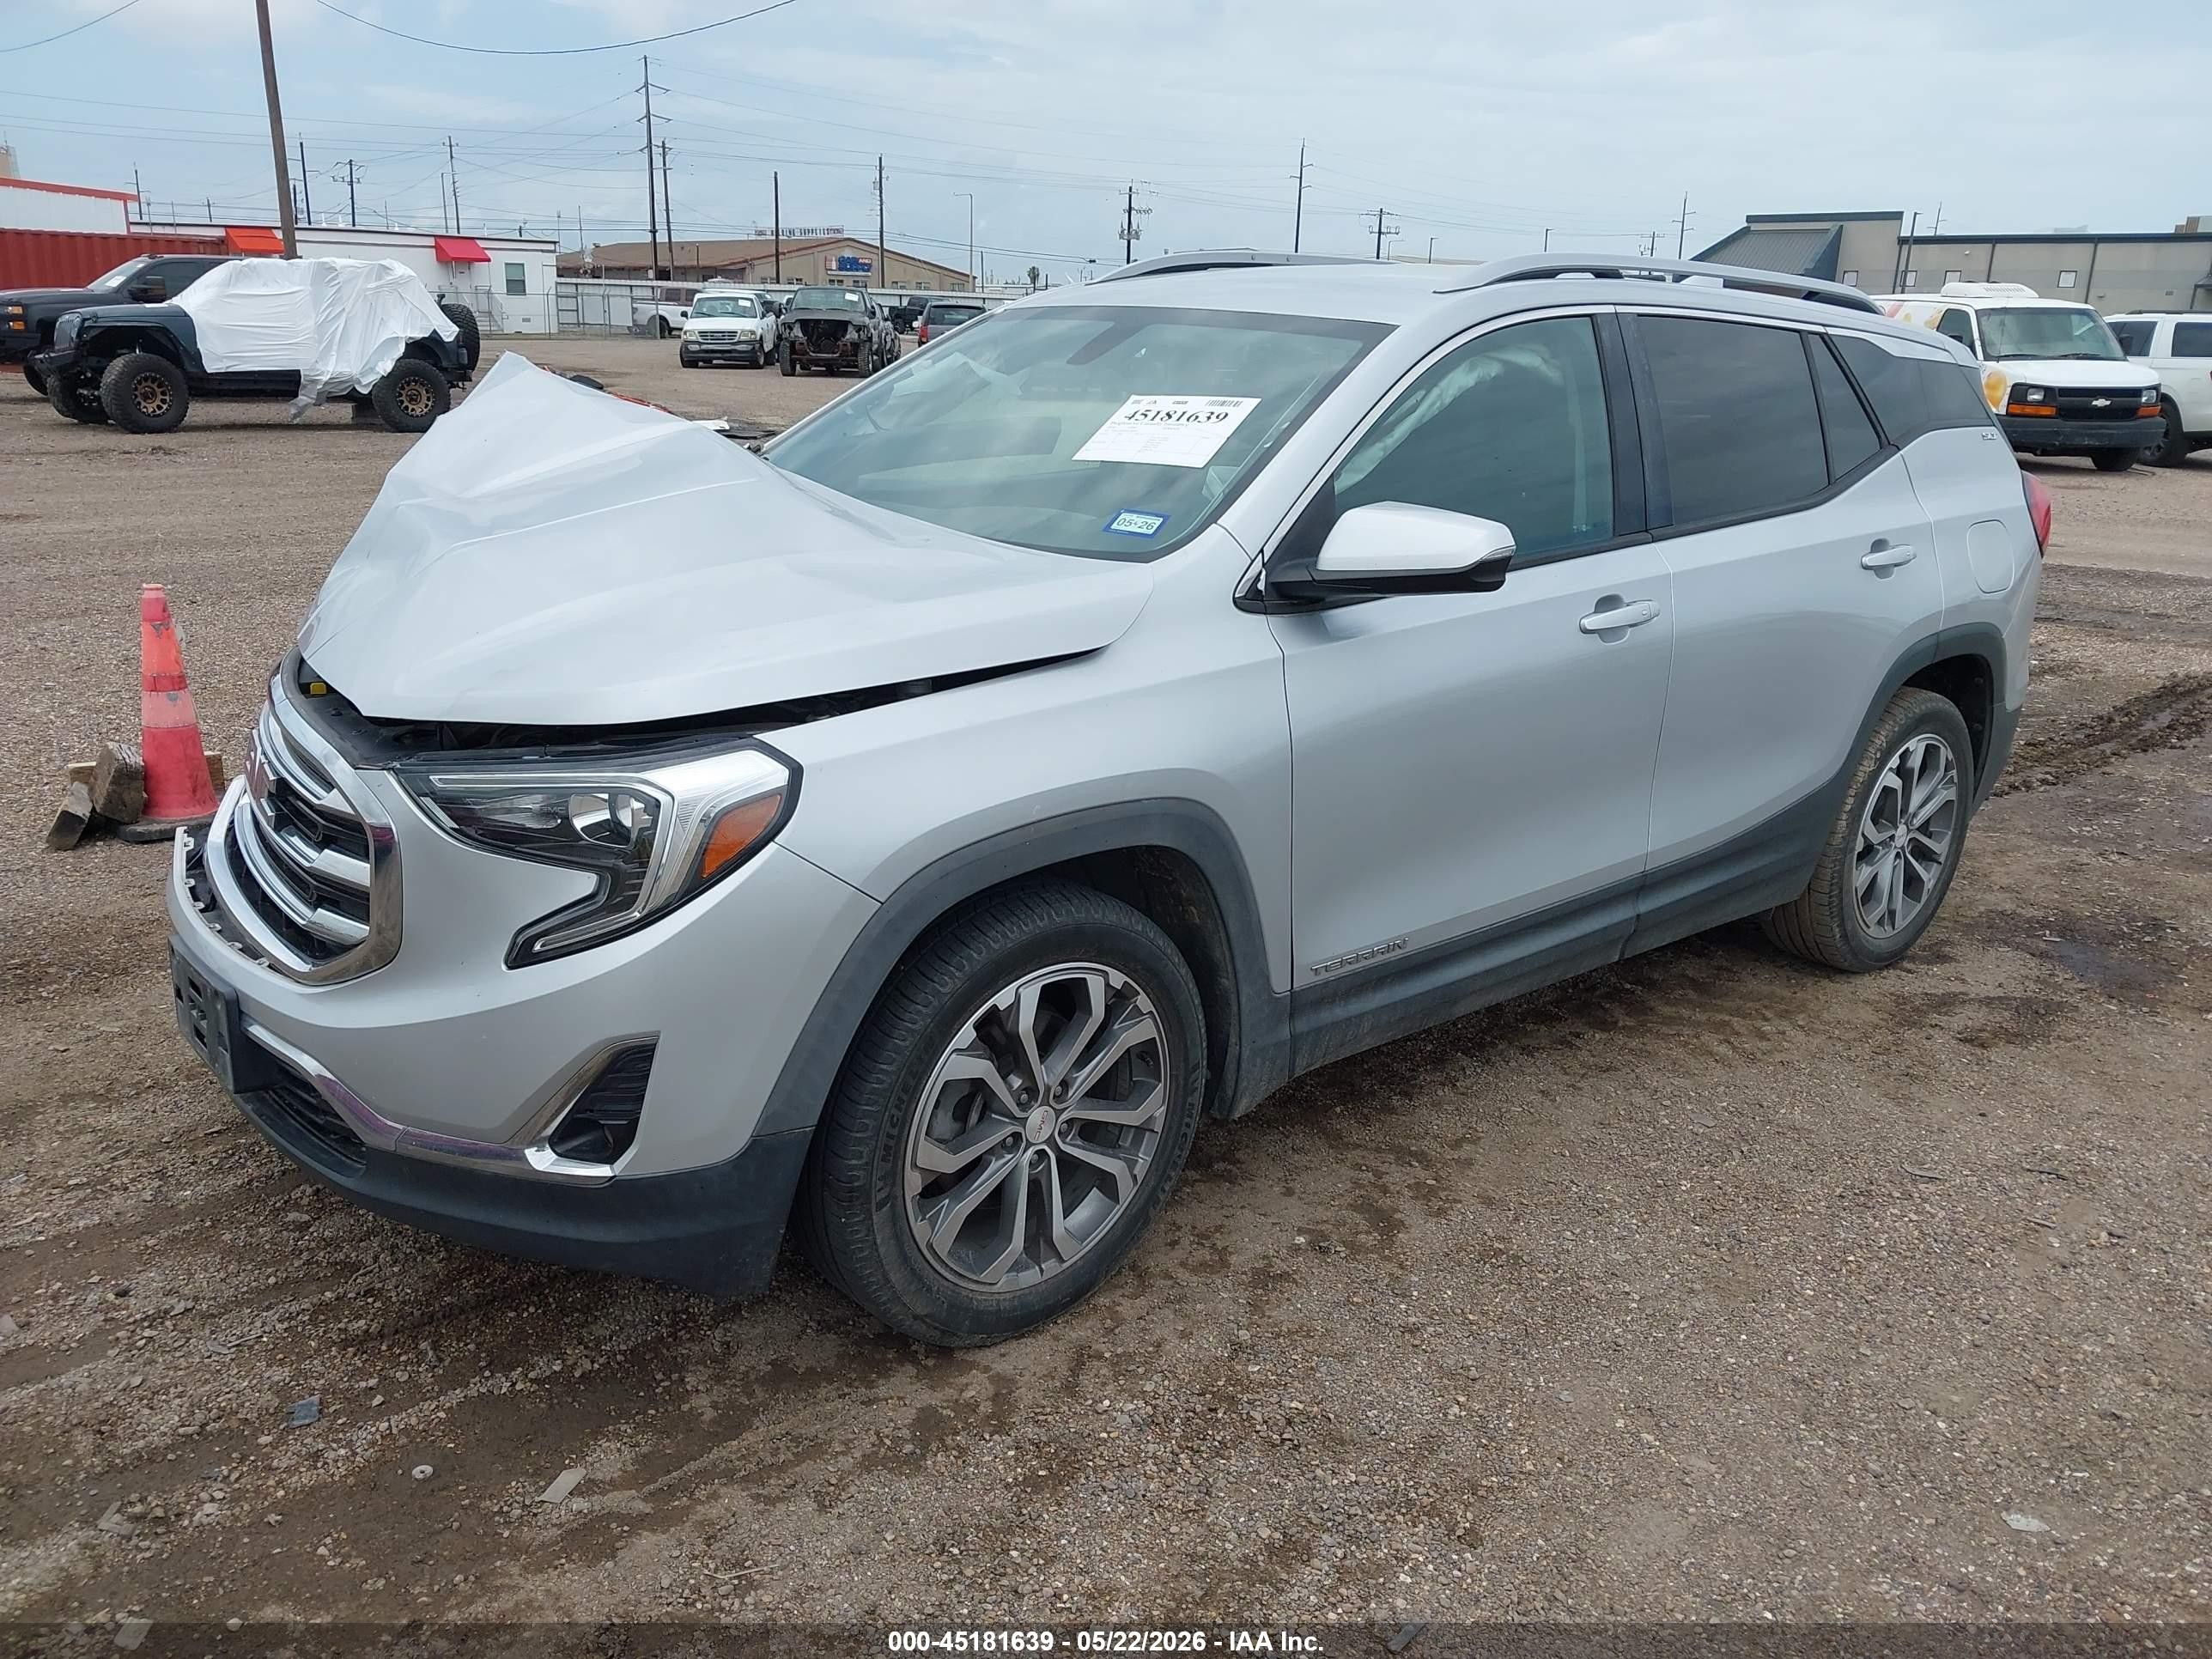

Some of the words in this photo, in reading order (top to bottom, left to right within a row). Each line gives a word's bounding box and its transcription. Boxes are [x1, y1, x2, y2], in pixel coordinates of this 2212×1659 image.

[1124, 409, 1229, 423] 45181639
[1310, 938, 1409, 976] TERRAIN
[1033, 1109, 1049, 1141] GMC
